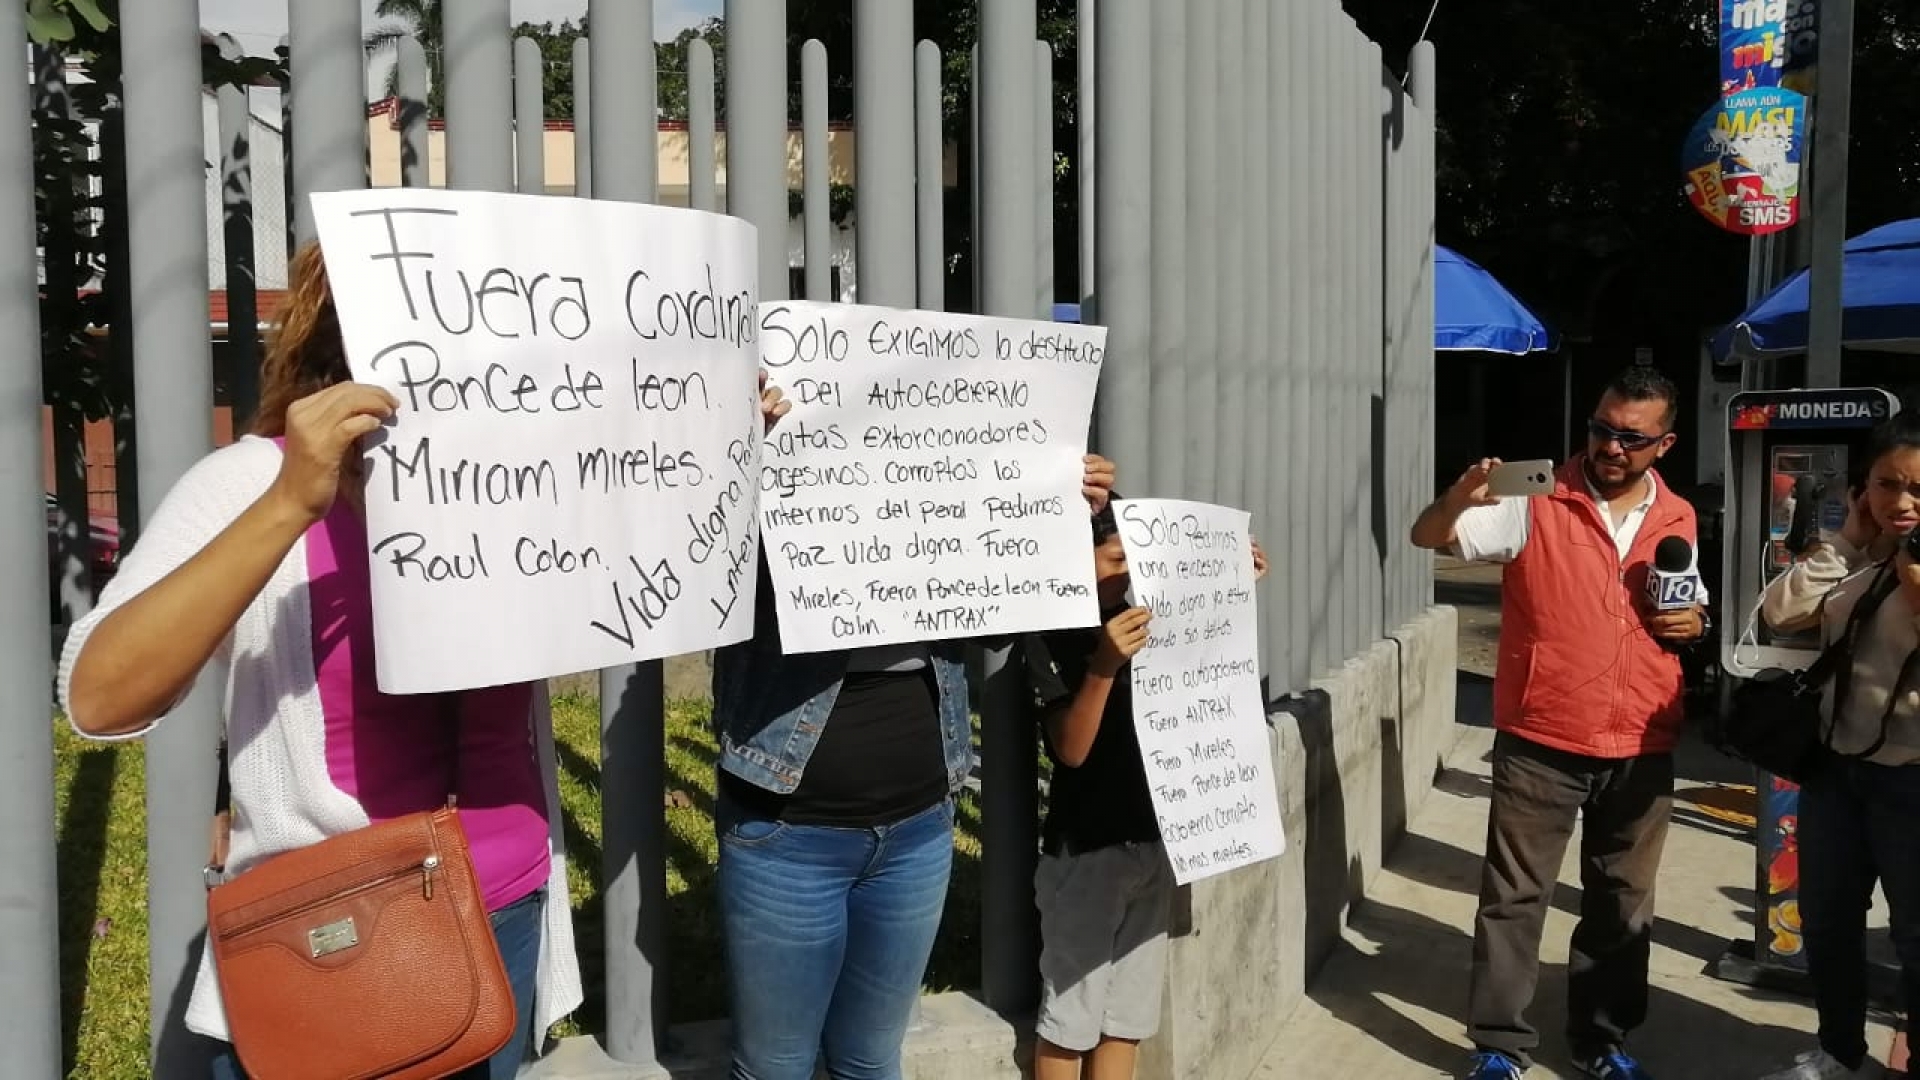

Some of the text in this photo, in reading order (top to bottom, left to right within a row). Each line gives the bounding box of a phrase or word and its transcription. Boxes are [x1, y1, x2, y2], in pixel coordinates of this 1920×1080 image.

[1740, 206, 1791, 226] SMS
[350, 207, 591, 341] Fuera
[761, 306, 849, 367] Solo
[868, 319, 981, 361] EXIGIMOS
[550, 362, 603, 413] de
[1779, 400, 1886, 420] MONEDAS
[380, 436, 559, 506] Miriam
[993, 458, 1022, 482] los
[877, 498, 911, 520] del
[982, 492, 1064, 522] Pedimos
[976, 528, 1040, 558] Fuera
[1122, 503, 1180, 548] Solo
[372, 532, 490, 584] Raul
[590, 554, 682, 650] Vida
[687, 480, 743, 566] digna
[1138, 560, 1169, 578] una
[865, 579, 918, 603] Fuera
[1046, 577, 1089, 598] Fuera
[1133, 665, 1174, 697] Fuera
[1143, 695, 1237, 733] Fuera ANTRAX
[1149, 736, 1236, 771] Fuera Mireles
[1154, 784, 1188, 804] Fuera
[1223, 766, 1237, 788] de
